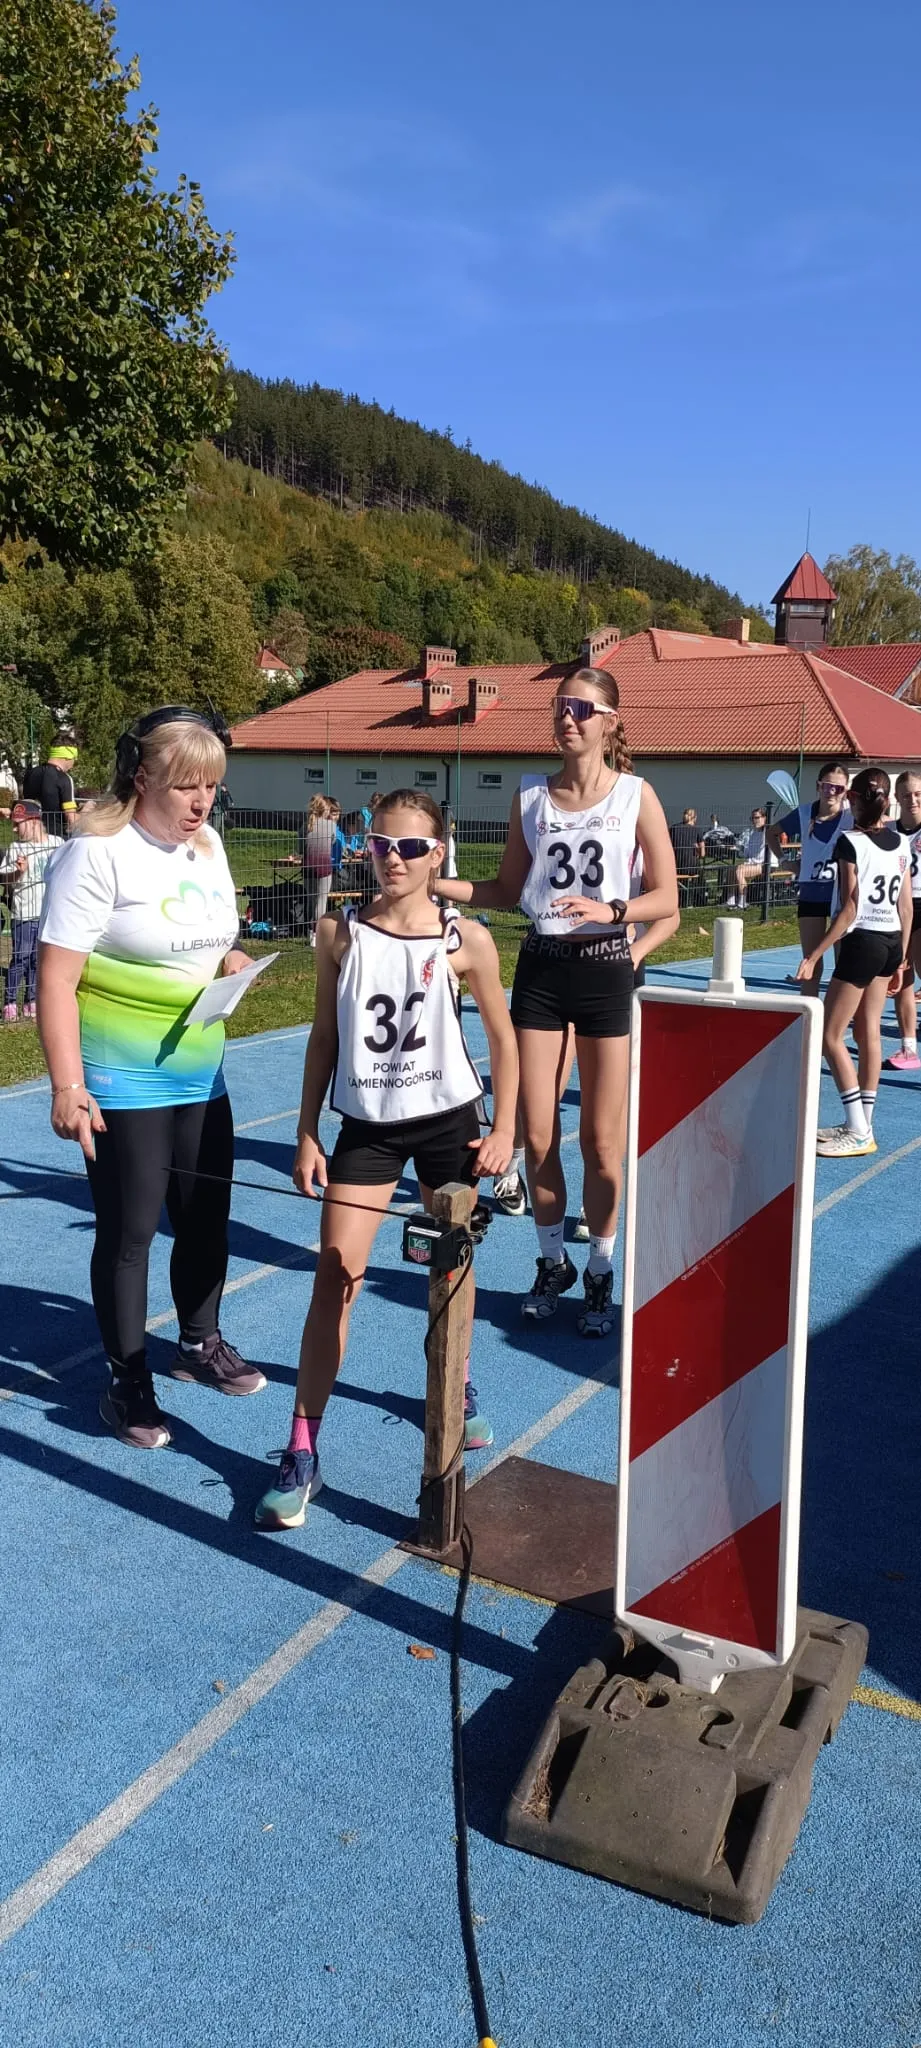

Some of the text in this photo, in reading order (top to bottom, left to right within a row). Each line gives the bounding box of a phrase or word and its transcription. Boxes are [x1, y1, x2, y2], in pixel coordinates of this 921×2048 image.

[546, 839, 605, 890] 33
[867, 874, 901, 906] 36
[171, 936, 233, 953] LUBAWK
[579, 939, 622, 958] NIKE
[363, 991, 427, 1054] 32
[372, 1060, 416, 1073] POWIAT
[412, 1238, 428, 1250] TAG
